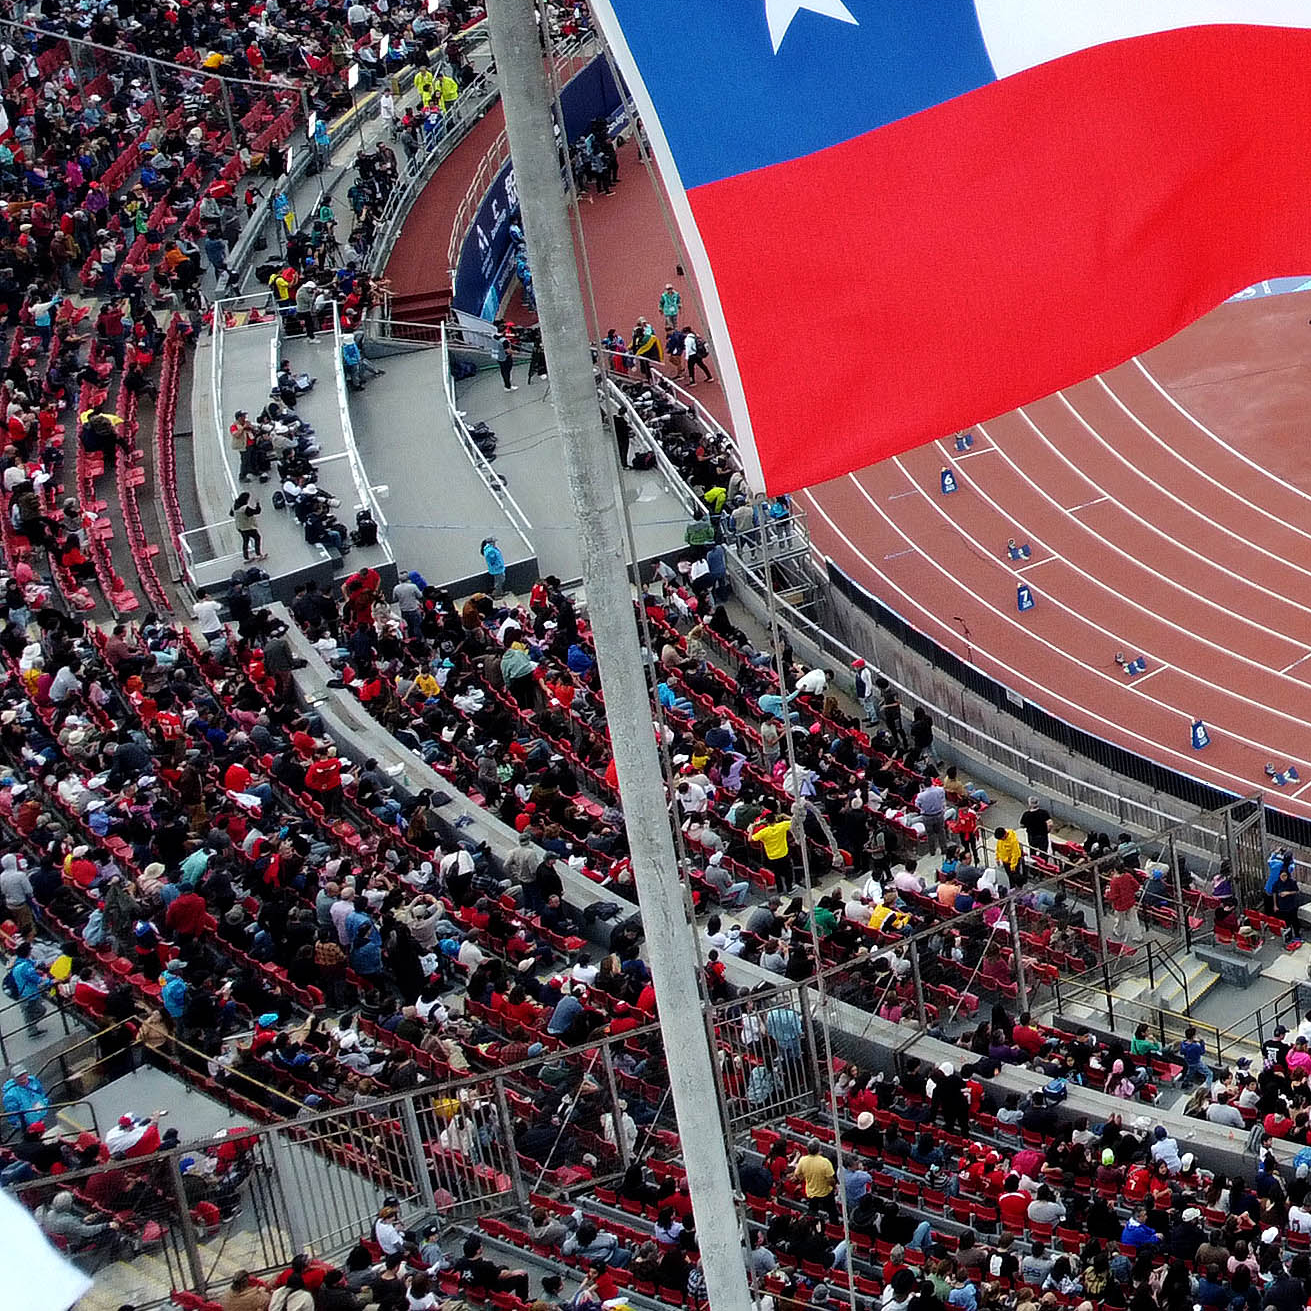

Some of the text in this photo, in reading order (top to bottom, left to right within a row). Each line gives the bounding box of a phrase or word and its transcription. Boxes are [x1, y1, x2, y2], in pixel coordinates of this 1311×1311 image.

[944, 474, 953, 485] 6
[1020, 590, 1028, 601] 7
[1196, 726, 1204, 738] 8
